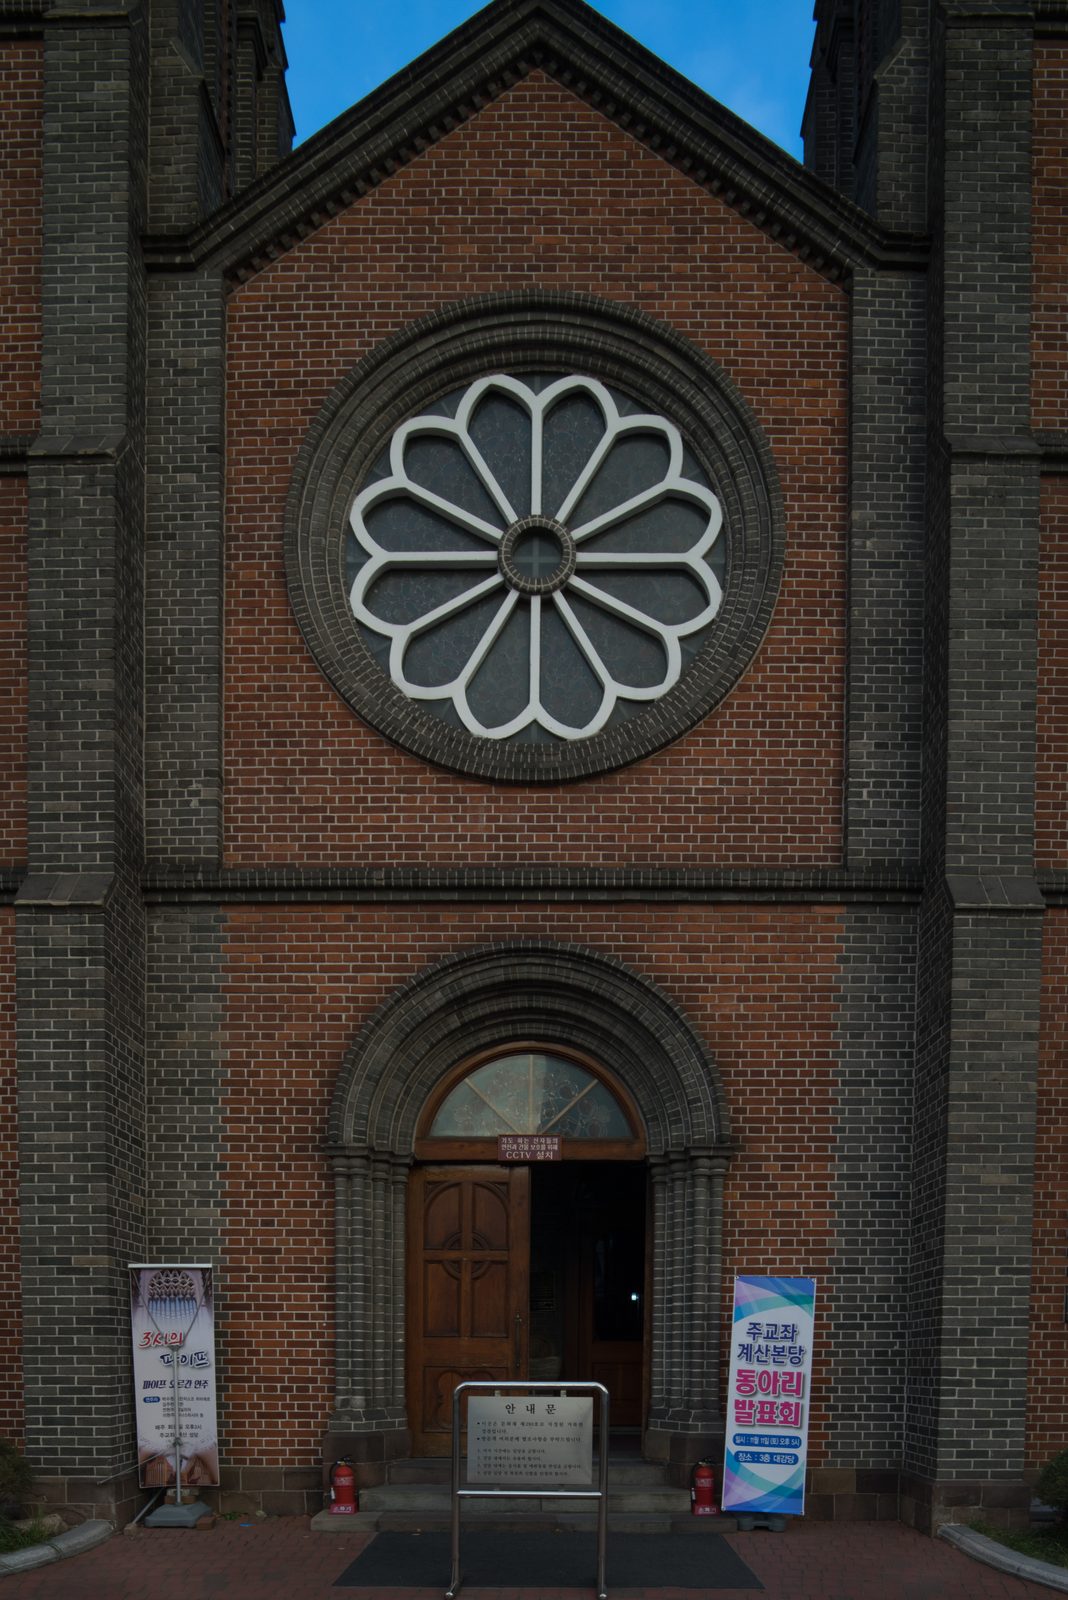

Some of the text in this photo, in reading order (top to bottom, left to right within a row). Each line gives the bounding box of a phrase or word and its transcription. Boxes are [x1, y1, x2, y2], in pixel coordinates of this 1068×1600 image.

[506, 1151, 553, 1160] CCTV 설치
[139, 1331, 183, 1347] 3시의
[746, 1322, 797, 1342] 주교좌
[160, 1351, 208, 1367] 파이프
[737, 1343, 804, 1365] 계산본당
[143, 1380, 167, 1389] 파이프
[194, 1380, 209, 1389] 연주
[735, 1369, 802, 1396] 동아리
[734, 1399, 801, 1426] 발표회
[738, 1452, 753, 1462] 장소
[759, 1453, 770, 1463] 3층
[773, 1454, 795, 1464] 대강당
